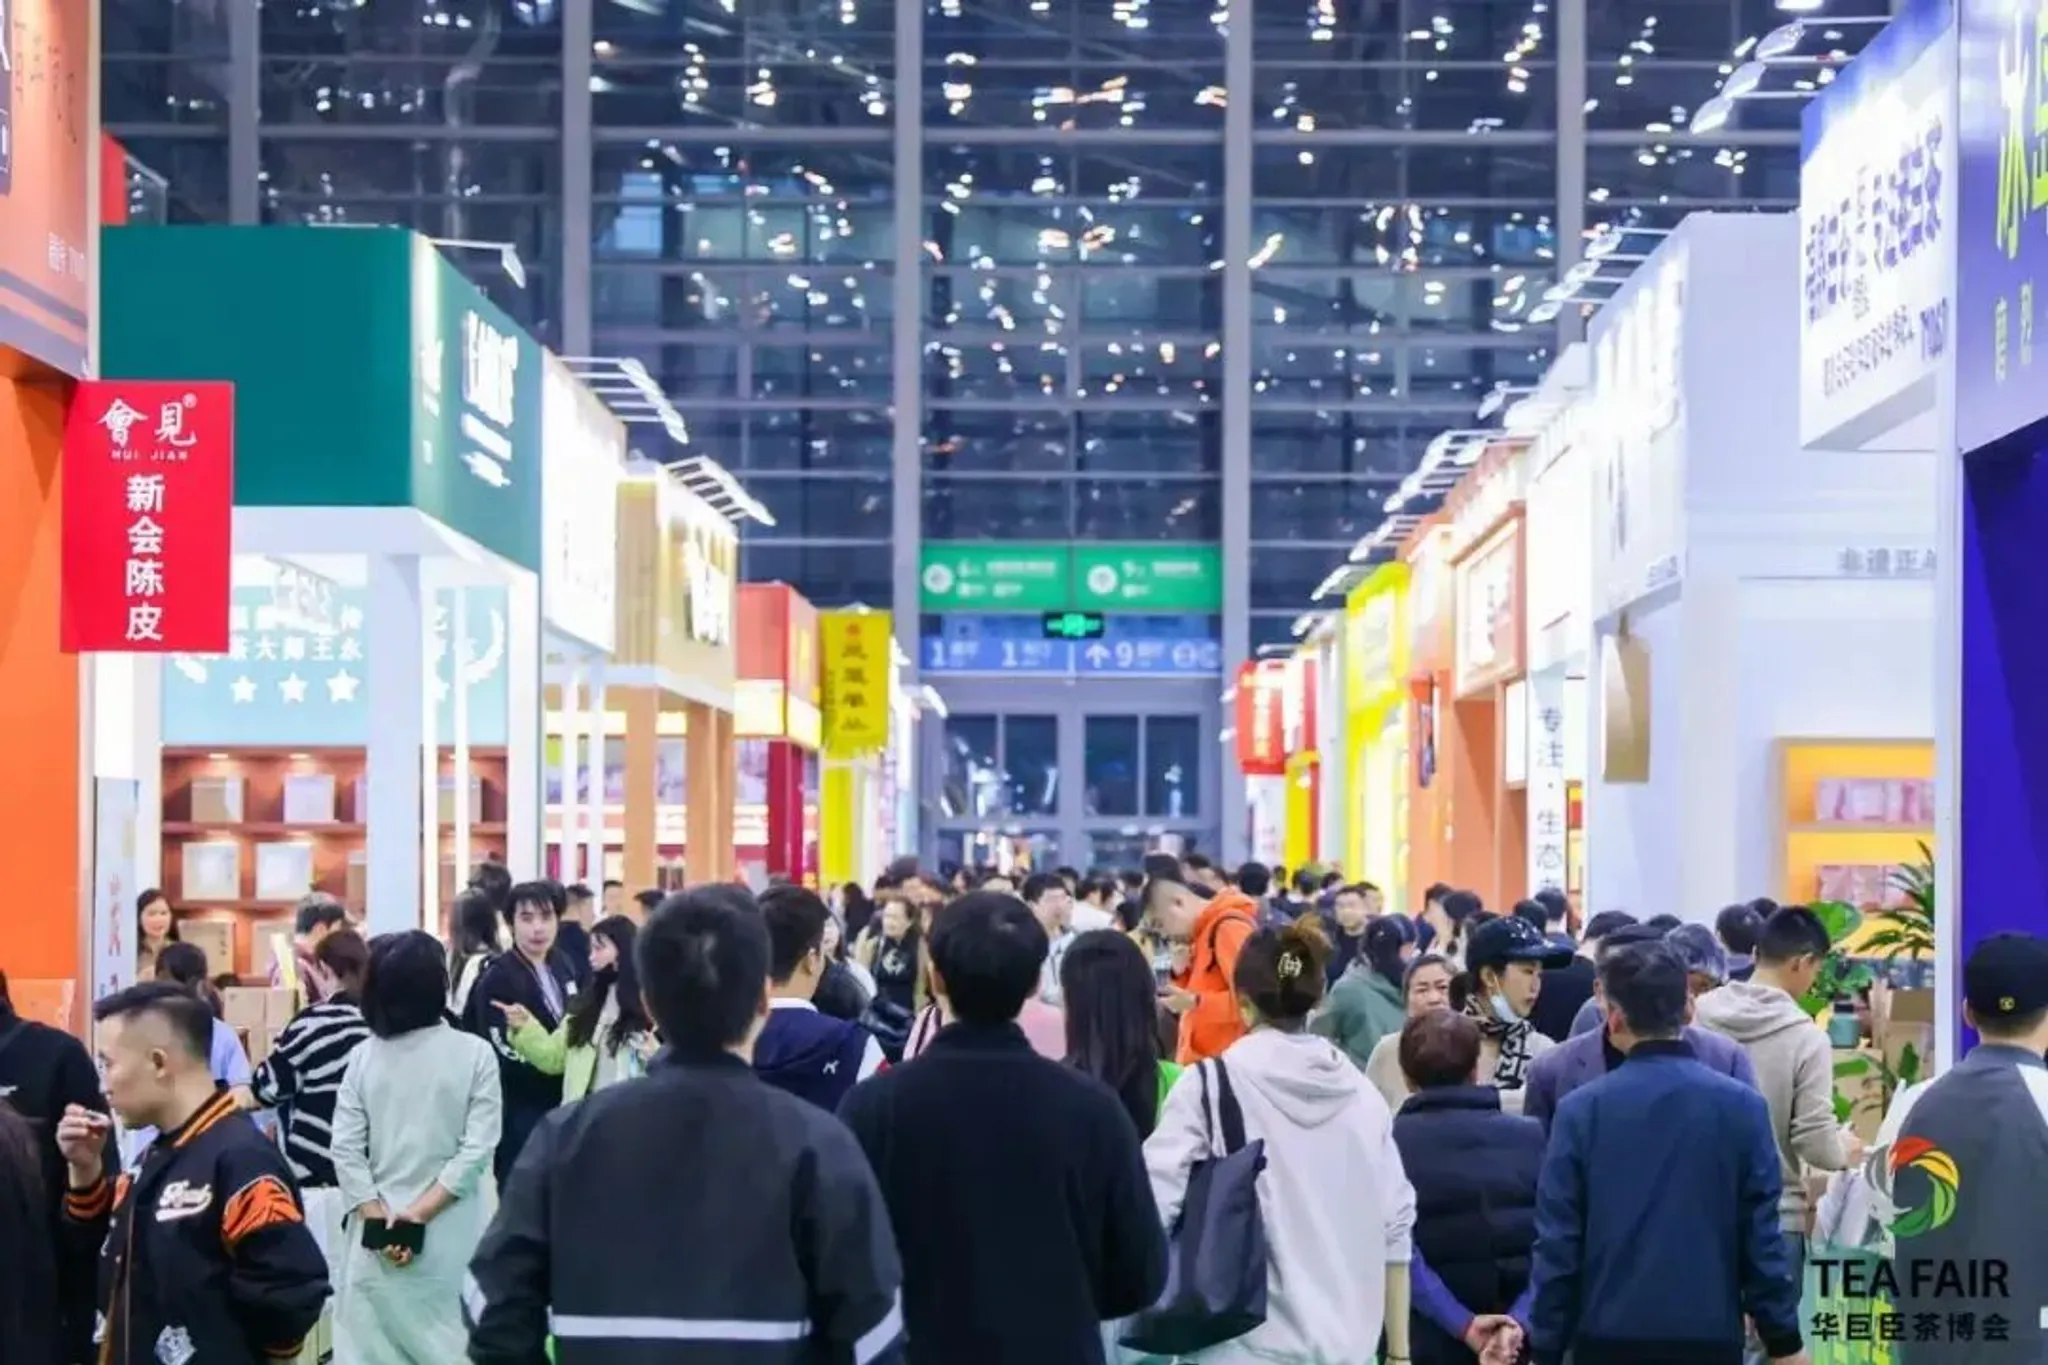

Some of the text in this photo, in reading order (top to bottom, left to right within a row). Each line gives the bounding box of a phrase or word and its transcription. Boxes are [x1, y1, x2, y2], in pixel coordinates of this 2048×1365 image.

[111, 450, 188, 461] HUI JIAN
[125, 474, 166, 641] 新会陈皮
